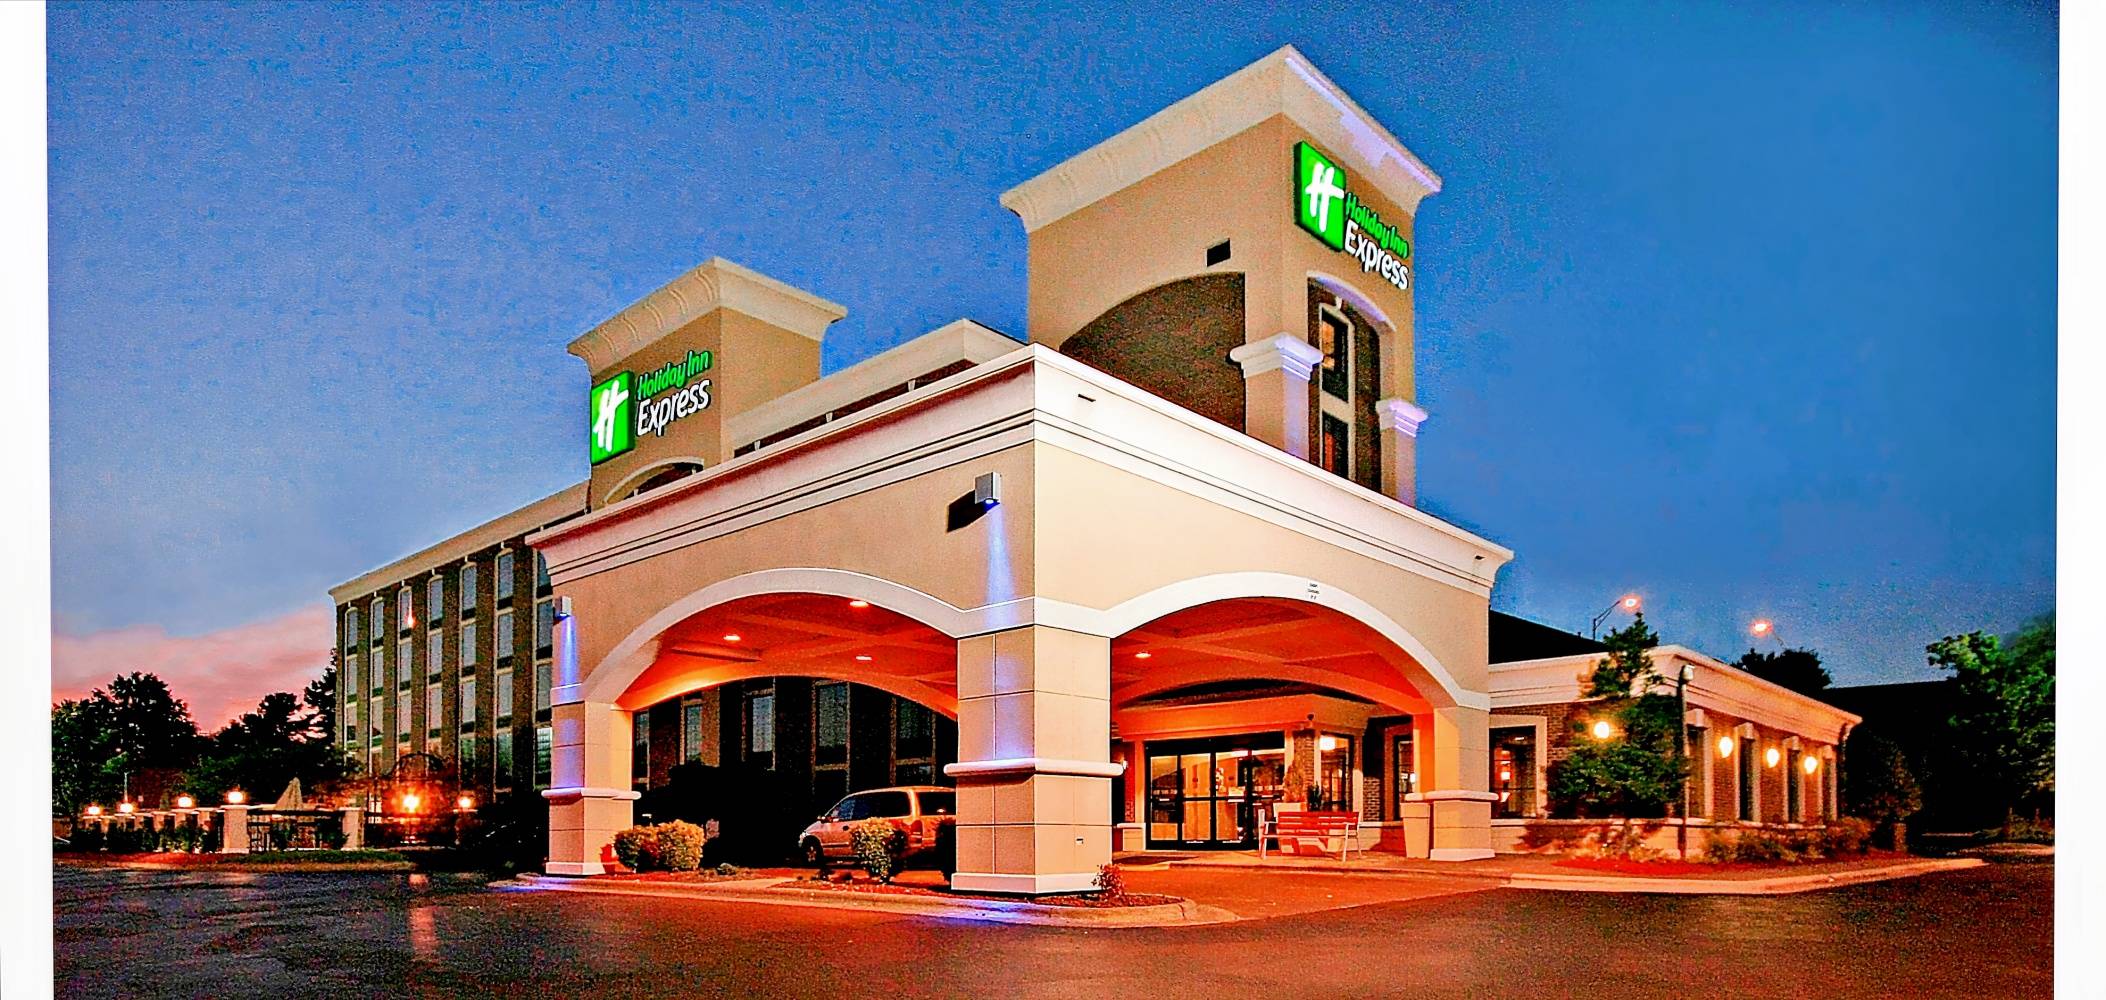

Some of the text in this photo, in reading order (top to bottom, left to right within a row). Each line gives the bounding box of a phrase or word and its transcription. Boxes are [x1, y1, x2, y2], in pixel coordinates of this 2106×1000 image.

[1344, 218, 1409, 290] Express
[1345, 191, 1409, 259] Holiday Inn
[637, 350, 711, 401] Holiday Inn
[637, 379, 712, 437] Express
